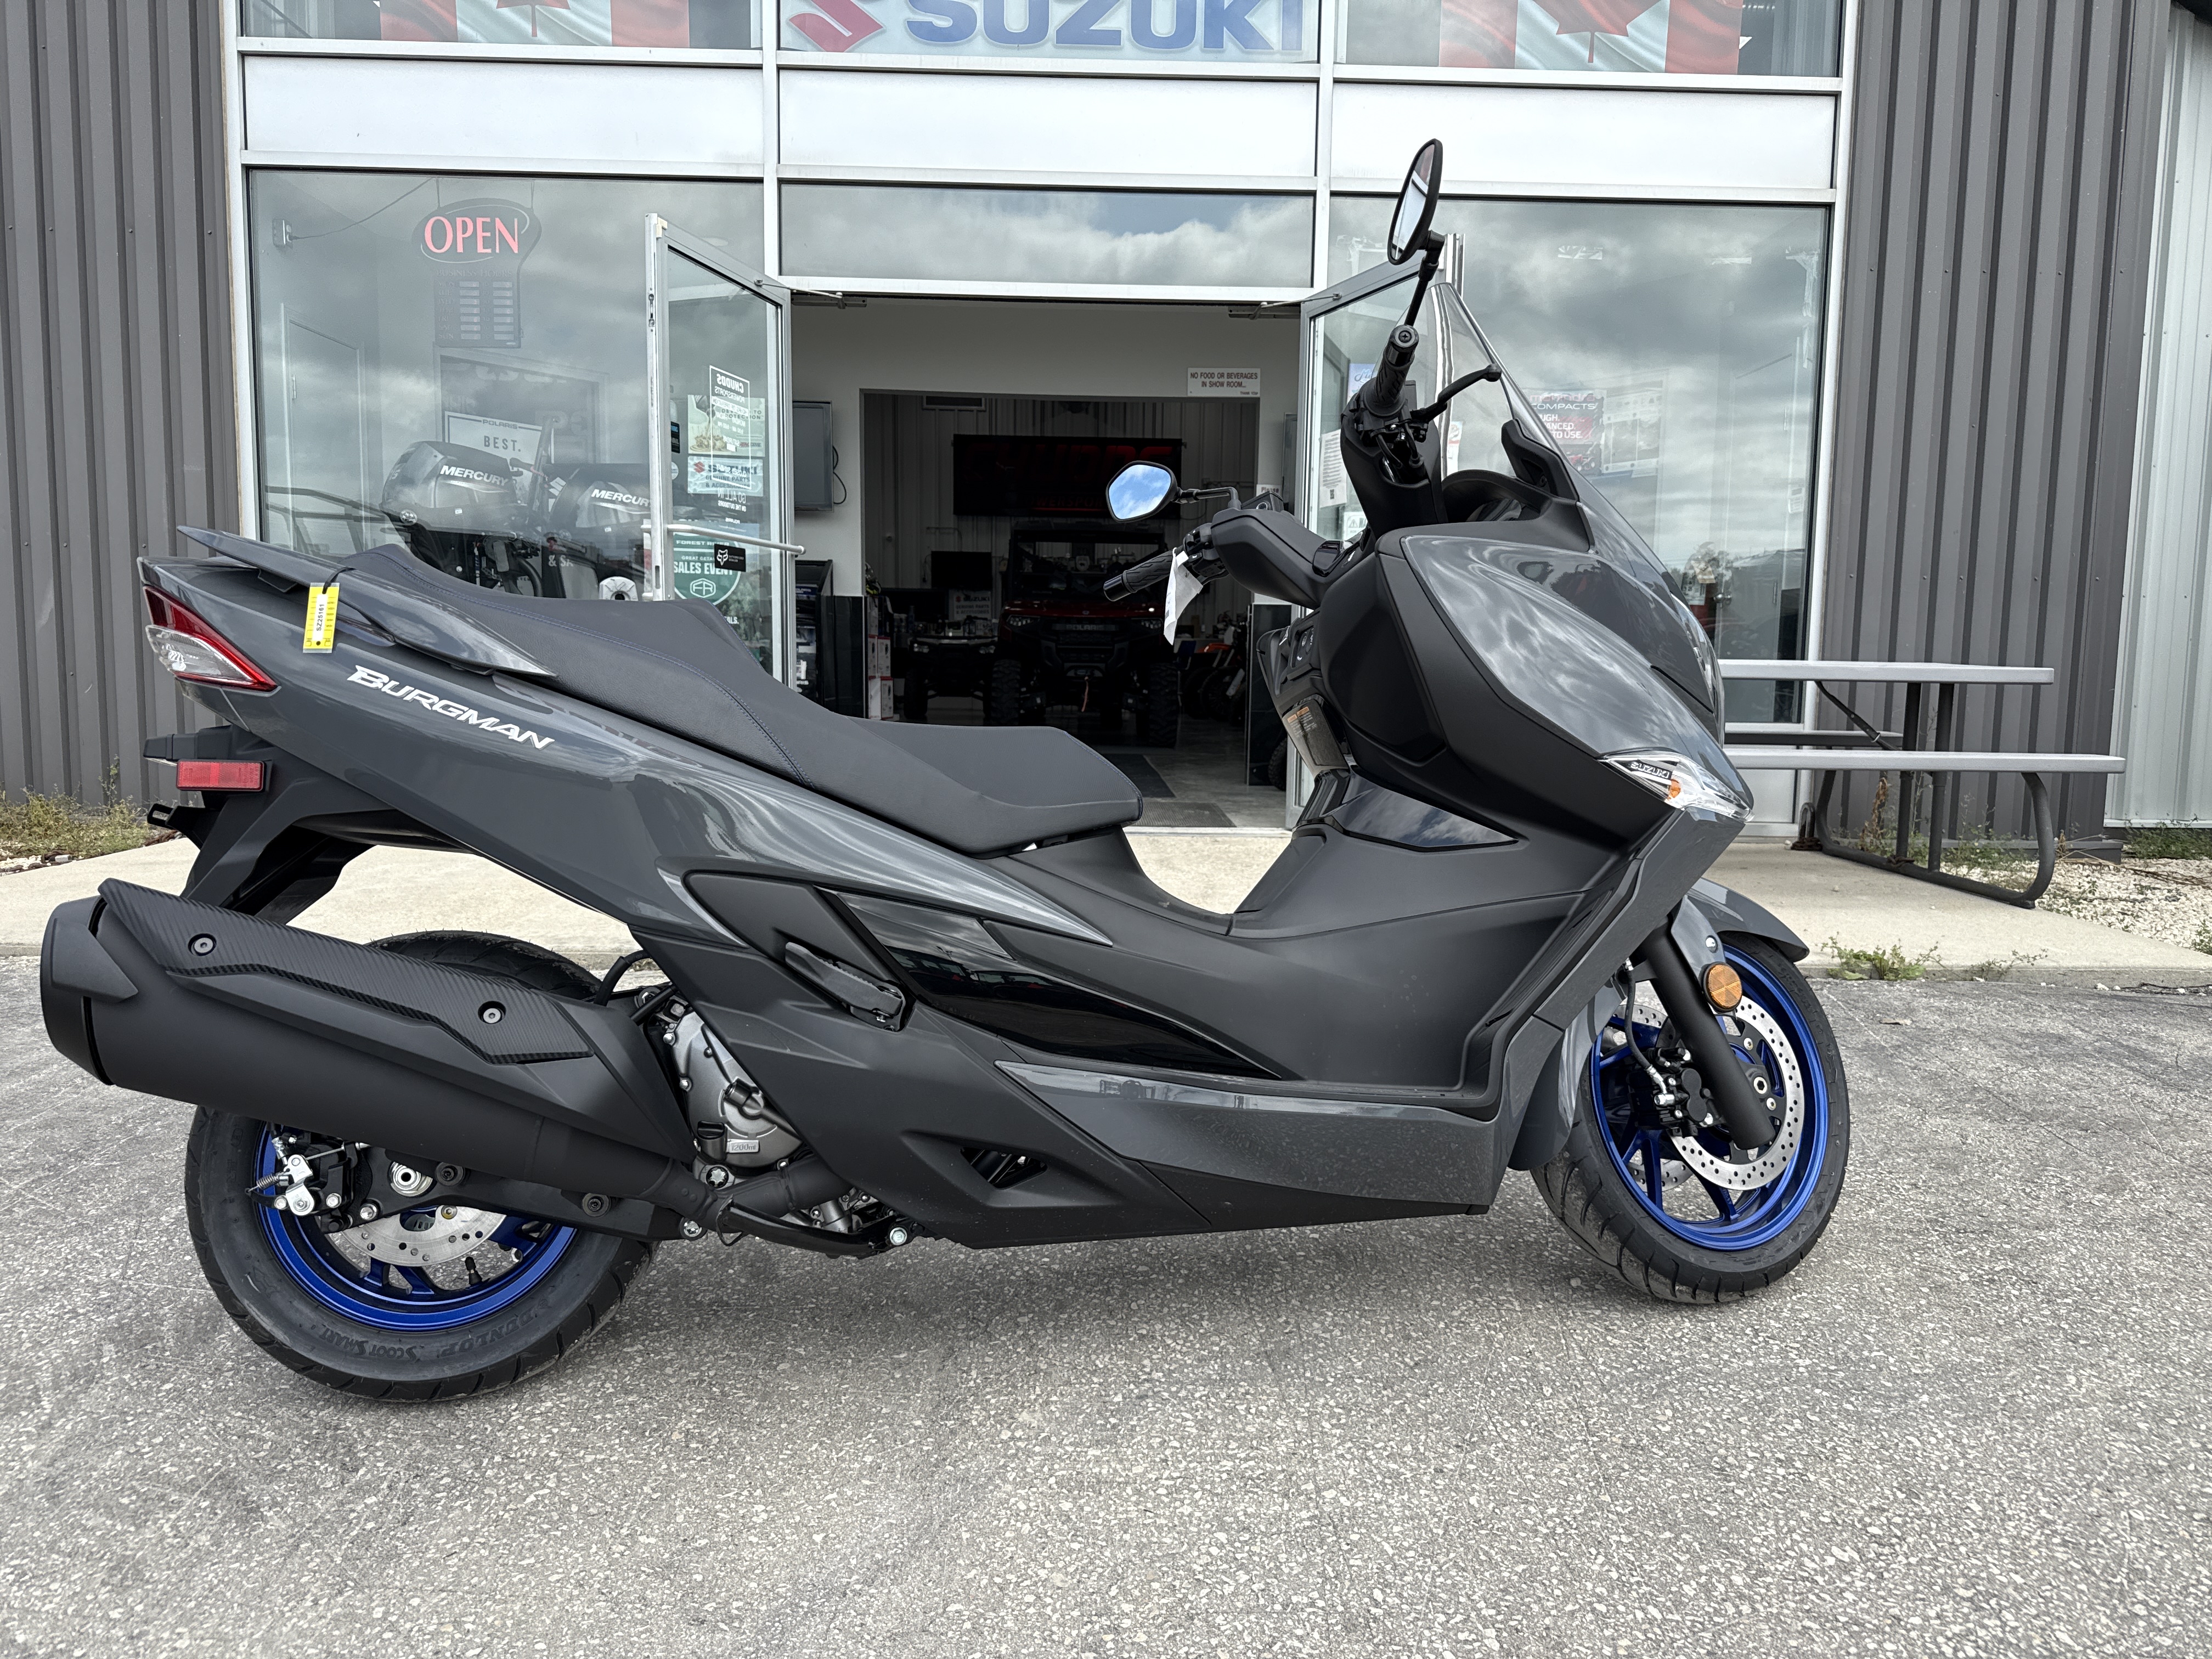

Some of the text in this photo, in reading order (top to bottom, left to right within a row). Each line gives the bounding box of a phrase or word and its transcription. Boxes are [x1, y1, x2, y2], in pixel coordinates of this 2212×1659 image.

[906, 0, 1302, 52] SUZUKI
[424, 216, 518, 253] OPEN
[482, 419, 519, 430] POLARIS
[483, 435, 521, 452] BEST.
[440, 465, 509, 487] MERCURY
[591, 489, 651, 507] MERCUR
[674, 561, 702, 574] SALES
[346, 664, 555, 751] BURGMAN
[1630, 761, 1670, 778] SUZUKI
[441, 1311, 533, 1357] DUNLOP
